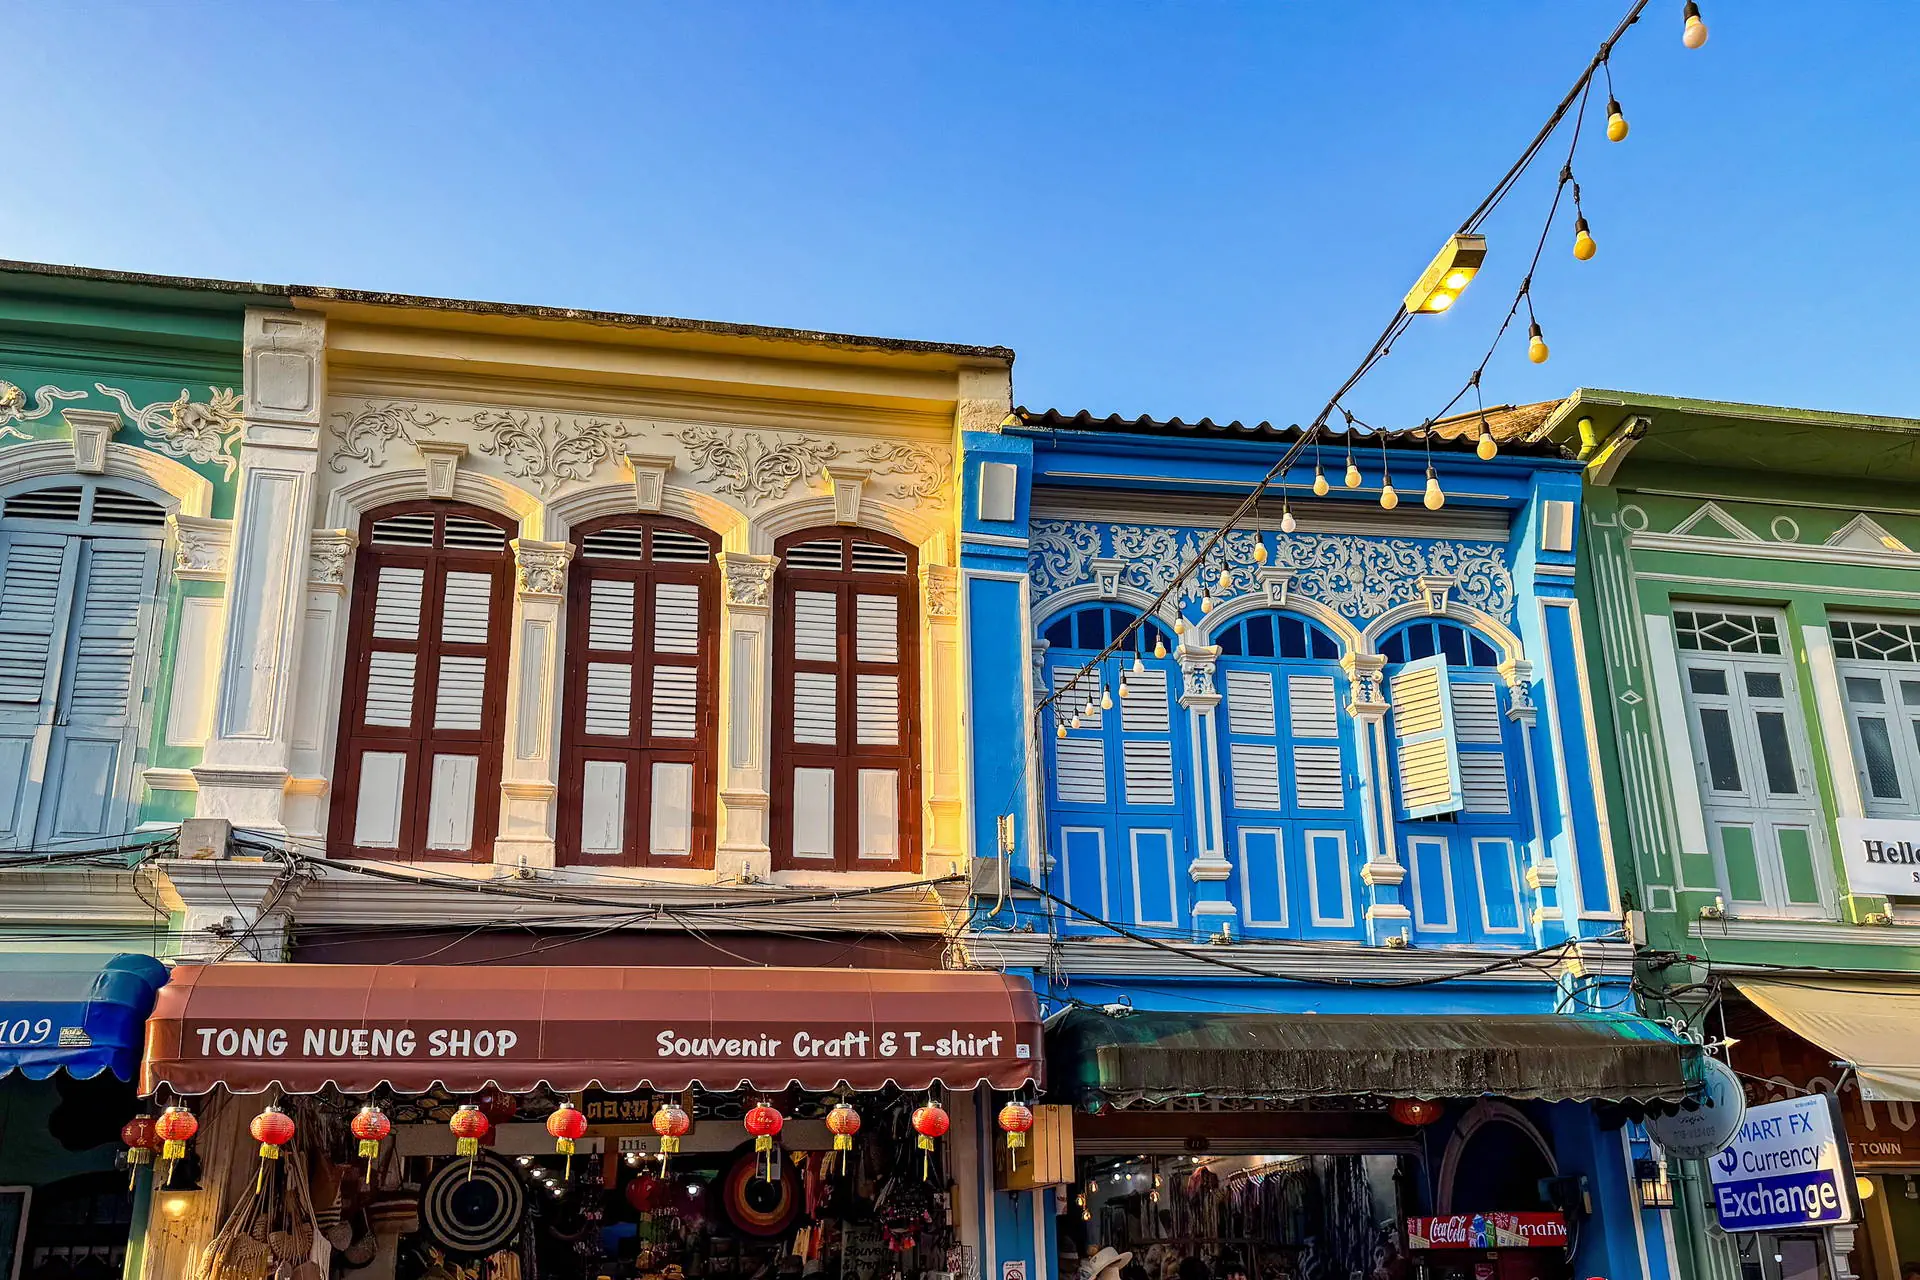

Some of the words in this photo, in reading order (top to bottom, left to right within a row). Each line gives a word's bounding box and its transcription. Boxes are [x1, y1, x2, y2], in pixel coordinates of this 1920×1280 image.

[0, 1018, 52, 1044] 109
[196, 1028, 288, 1056] TONG
[302, 1028, 416, 1057] NUENG
[428, 1029, 518, 1057] SHOP
[656, 1030, 782, 1057] Souvenir
[793, 1031, 869, 1056] Craft
[879, 1032, 898, 1056] &
[904, 1030, 1003, 1056] T-shirt
[1788, 1112, 1813, 1135] FX
[1743, 1145, 1819, 1173] Currency
[1859, 1142, 1902, 1155] TOWN
[1718, 1182, 1837, 1219] Exchange
